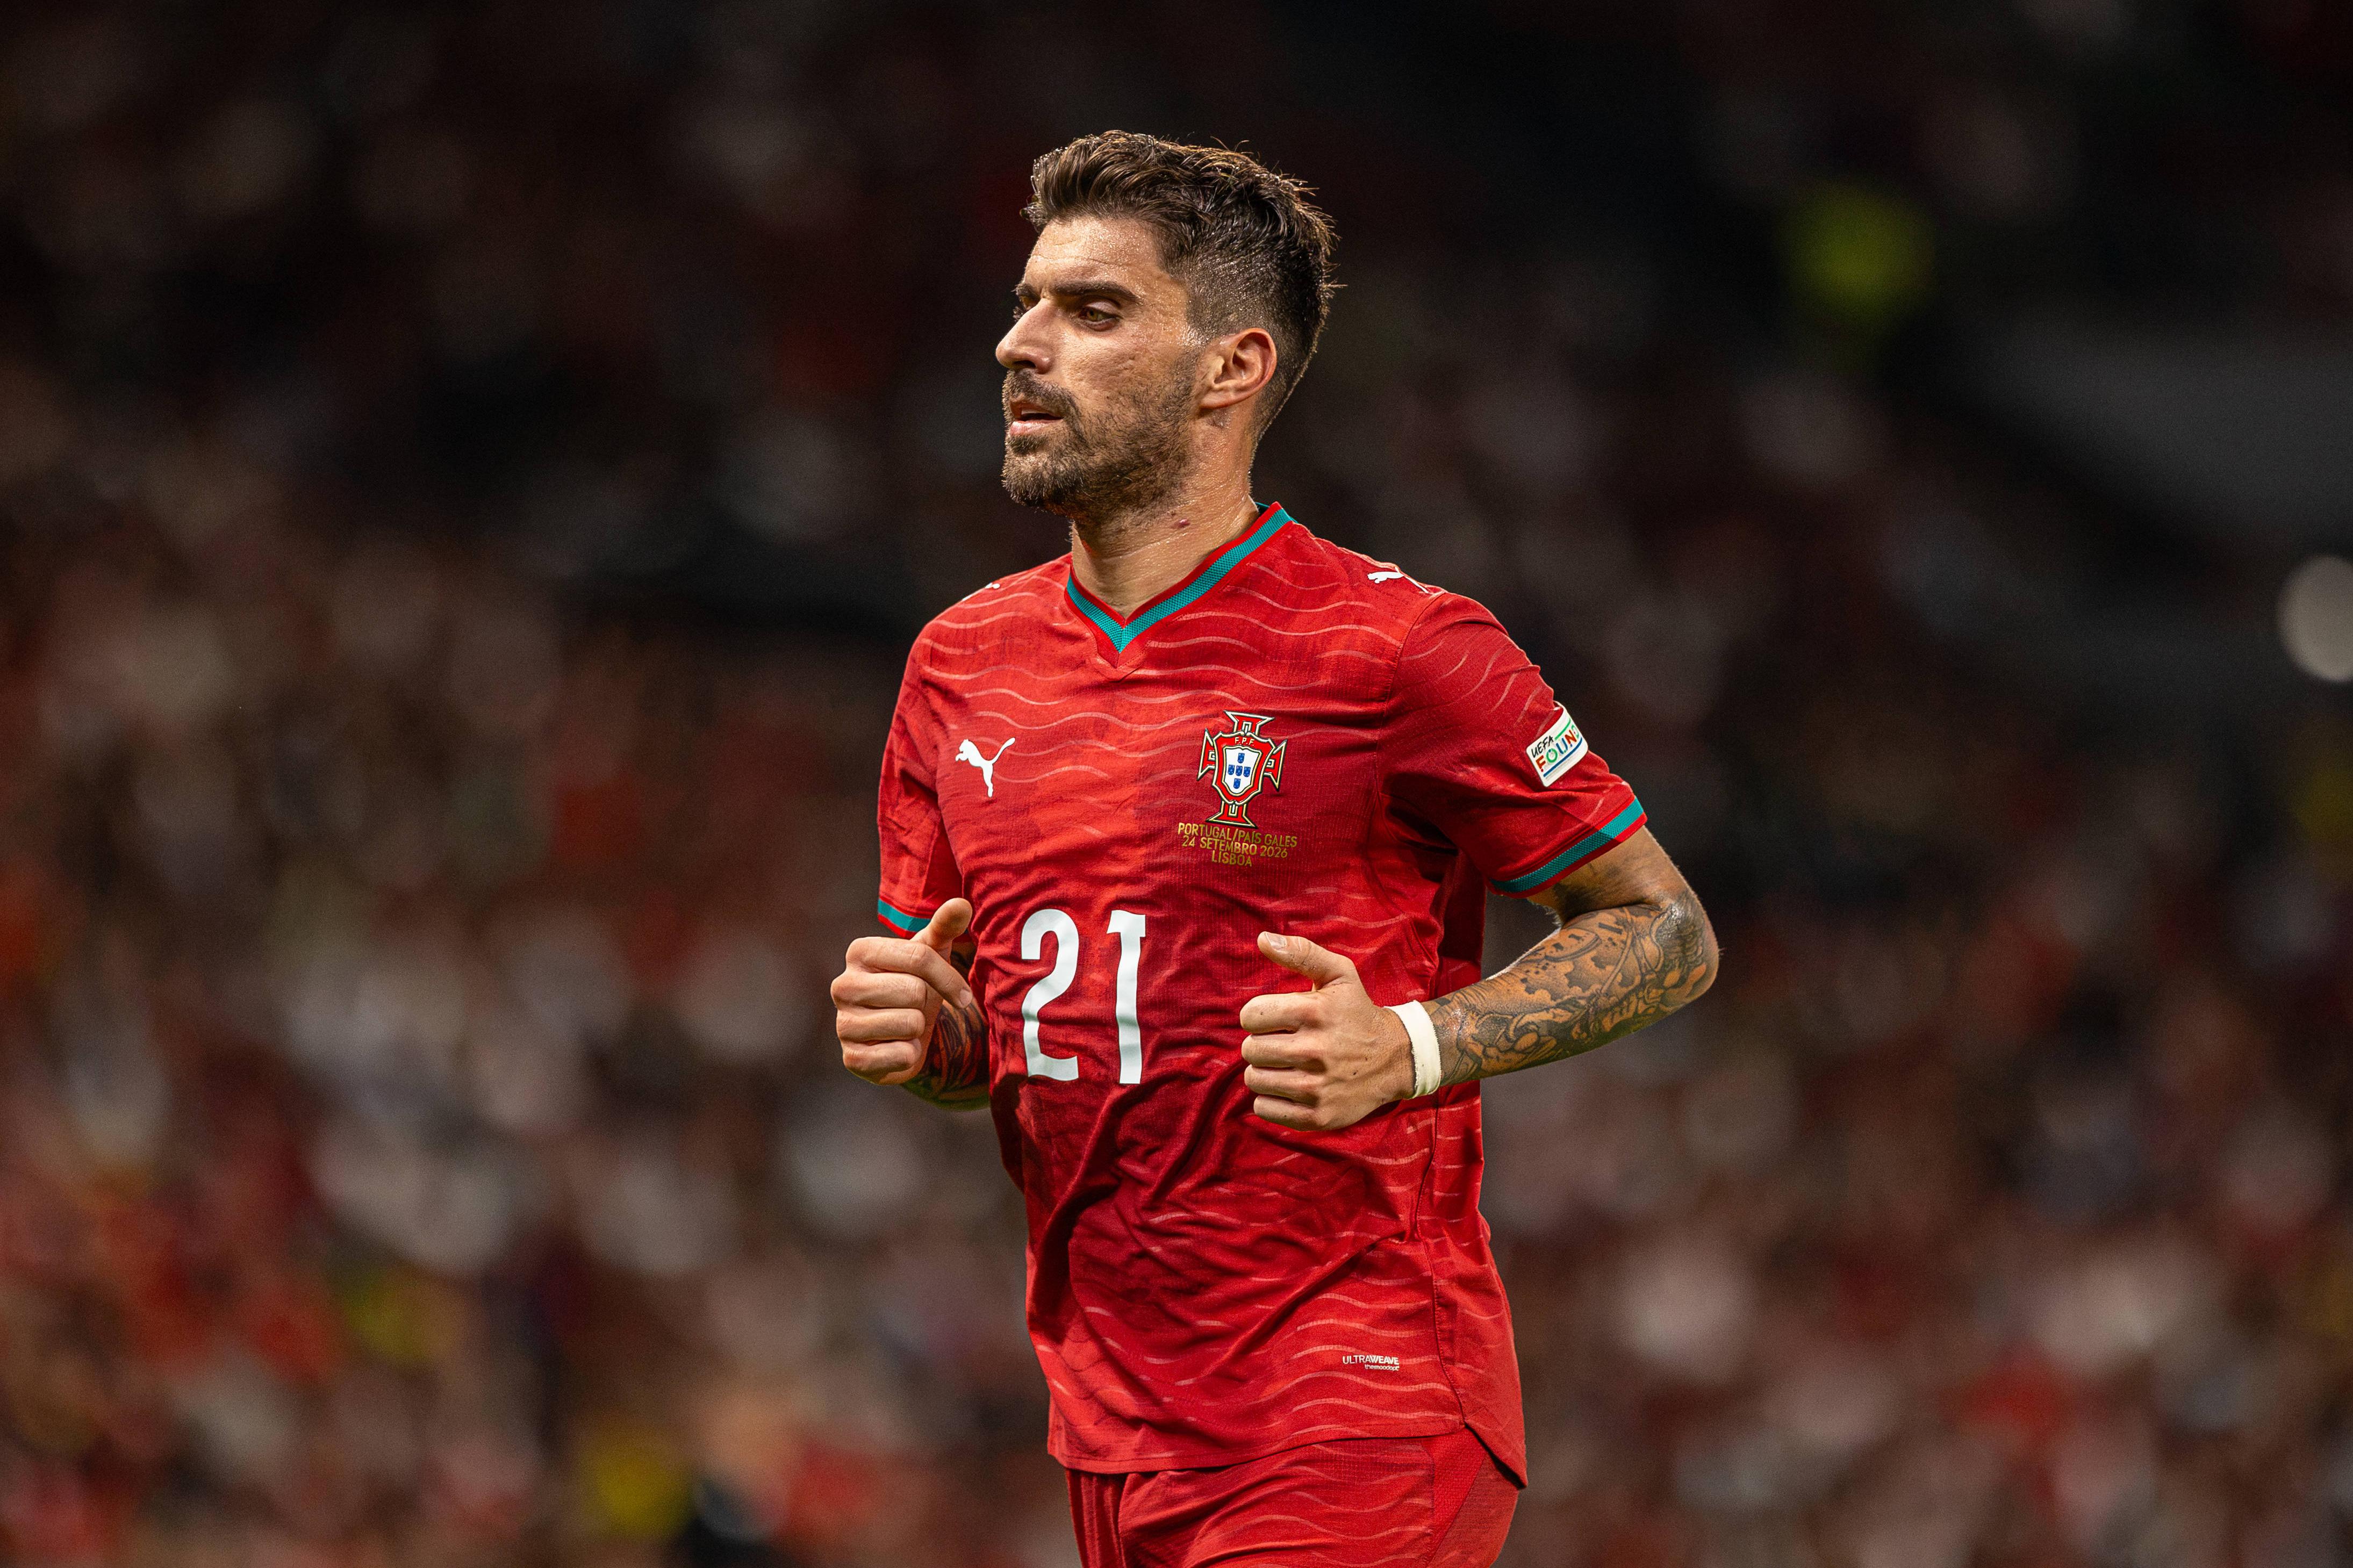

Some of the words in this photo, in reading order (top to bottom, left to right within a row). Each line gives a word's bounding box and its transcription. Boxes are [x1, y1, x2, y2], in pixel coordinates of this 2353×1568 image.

[1531, 735, 1554, 758] UEFA
[1178, 822, 1261, 844] PORTUGAL/PAÍS
[1264, 833, 1298, 847] GALES
[1182, 836, 1195, 847] 24
[1200, 837, 1257, 855] SETEMBRO
[1260, 845, 1288, 858] 2026
[1211, 850, 1252, 867] LISBOA
[1021, 908, 1146, 1084] 21
[1342, 1355, 1400, 1365] ULTRAWEAVE
